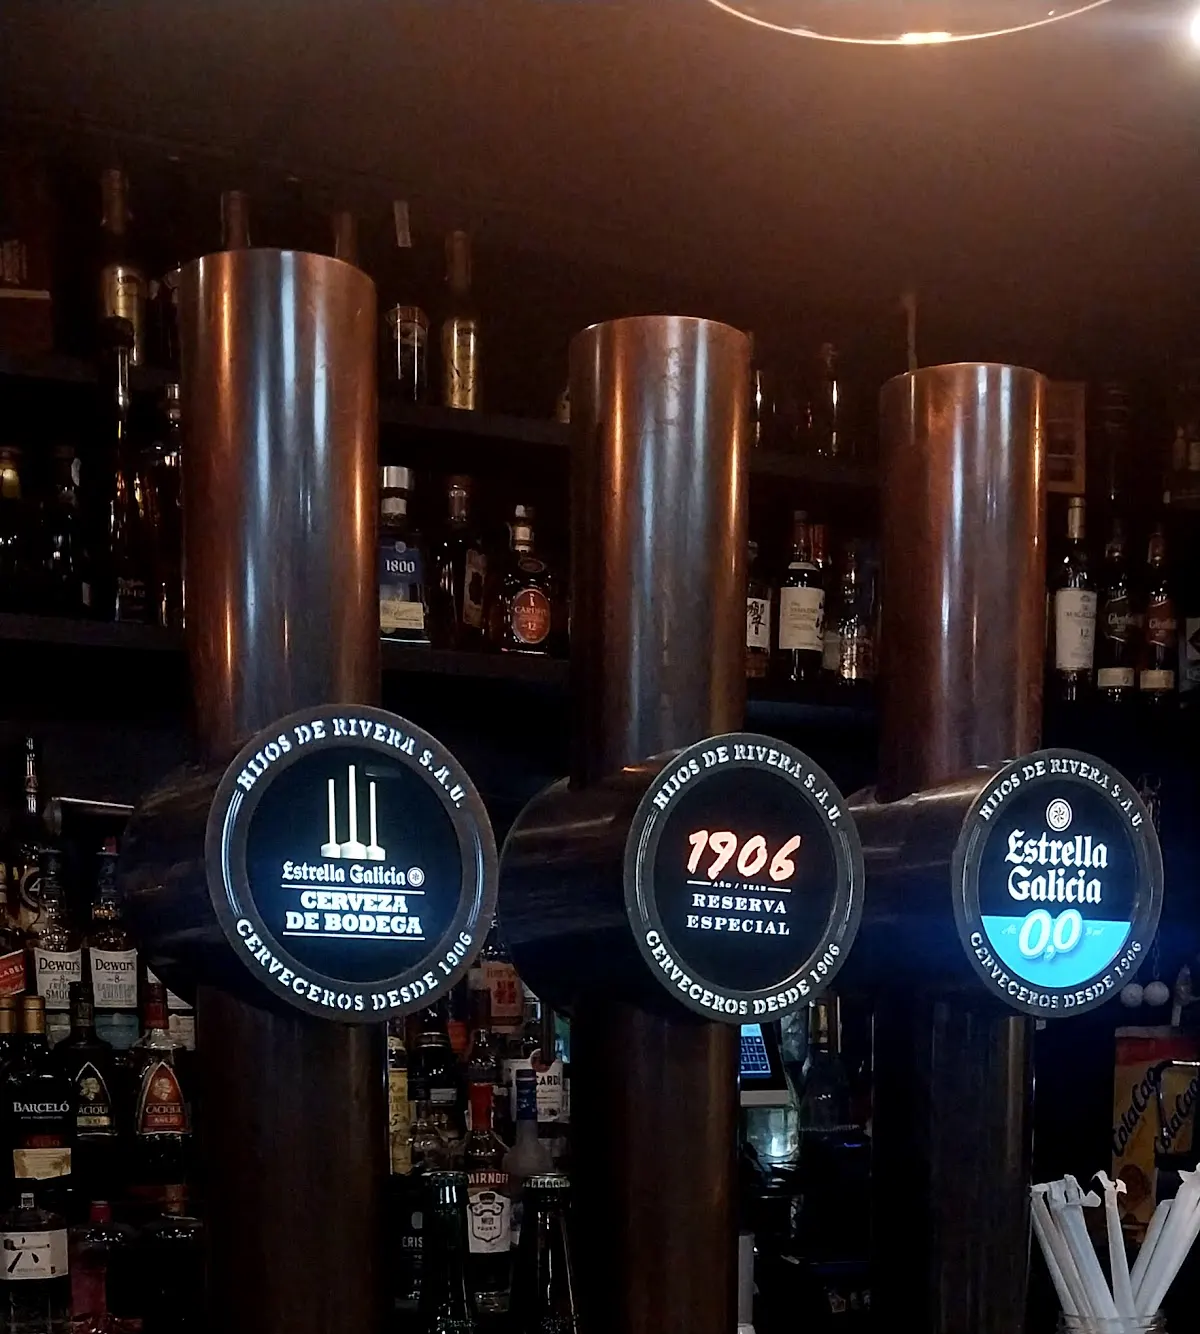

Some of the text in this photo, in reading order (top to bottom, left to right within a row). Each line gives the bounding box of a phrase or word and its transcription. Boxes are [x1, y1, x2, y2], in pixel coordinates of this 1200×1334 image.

[385, 559, 415, 574] 1800
[237, 718, 466, 808] HIJOS DE RIVERA S.A.U.
[653, 744, 842, 827] HIJOS DE RIVERA S.A.U.
[979, 758, 1144, 832] HIJOS DE RIVERA S.A.U.
[687, 830, 801, 881] 1906
[1004, 828, 1108, 868] Estrella
[282, 861, 406, 885] Estrella Galicia
[1008, 866, 1102, 904] Galicia
[300, 891, 408, 913] CERVEZA
[692, 893, 786, 914] RESERVA
[286, 912, 422, 934] DE BODEGA
[686, 915, 790, 935] ESPECIAL
[1018, 909, 1082, 959] 0,0
[237, 919, 473, 1011] CERVECEROS DESDE 1906
[645, 929, 841, 1014] CERVECEROS DESDE 1906
[970, 932, 1142, 1009] CERVECEROS DESDE 1906
[46, 989, 70, 999] SMOO
[13, 1101, 70, 1114] BARCELÓ
[467, 1172, 509, 1184] MIRNOFF
